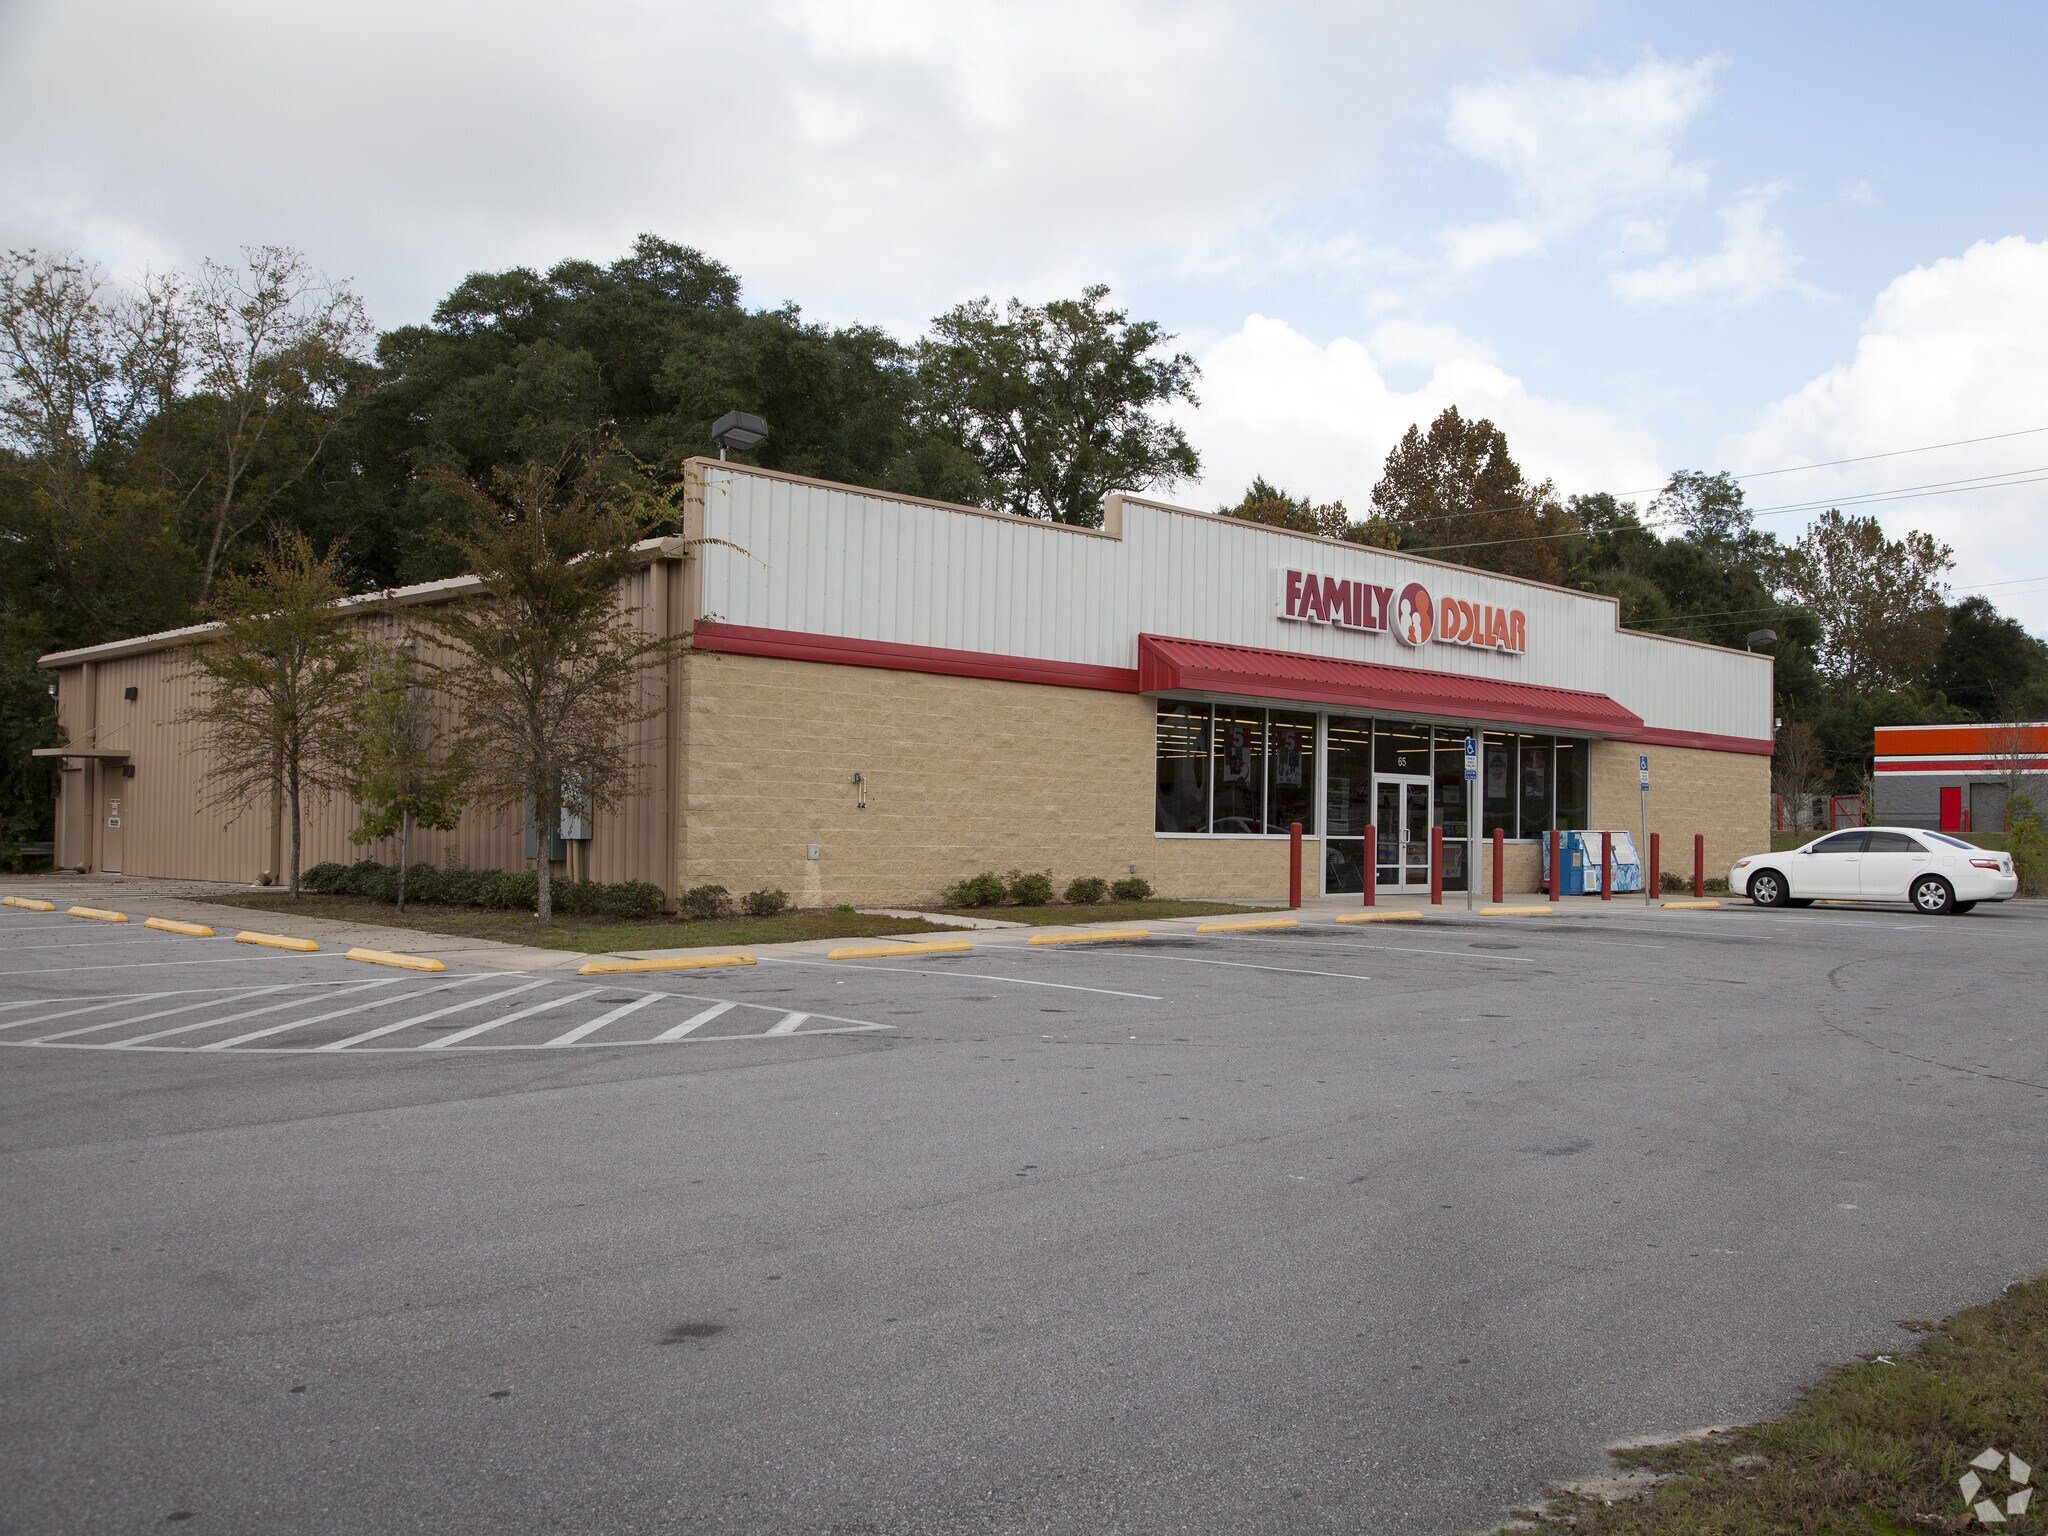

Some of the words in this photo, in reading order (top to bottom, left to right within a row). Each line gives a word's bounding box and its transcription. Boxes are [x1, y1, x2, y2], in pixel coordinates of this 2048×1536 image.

[1285, 569, 1394, 631] FAMILY
[1440, 596, 1526, 652] DOLLAR
[1397, 756, 1407, 767] 65
